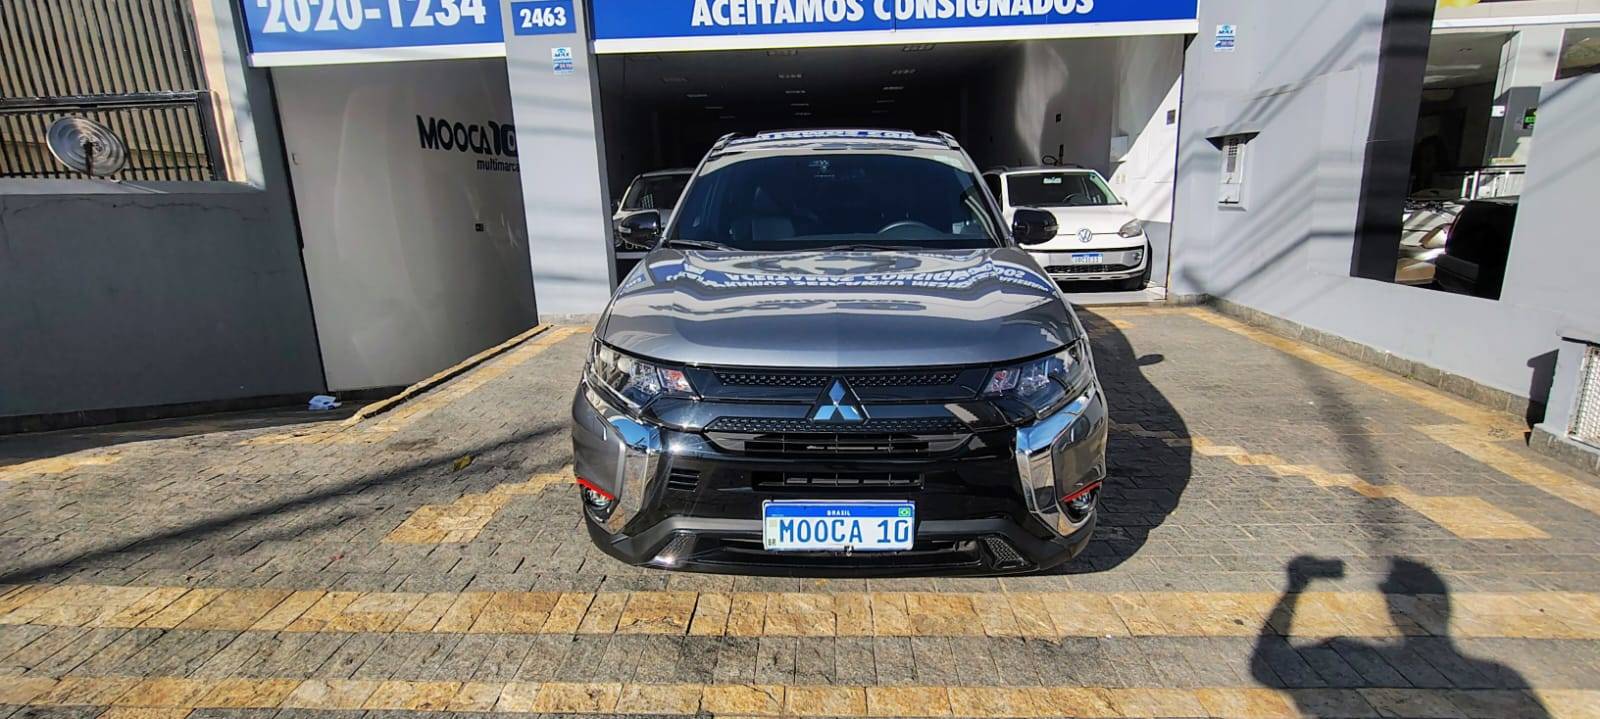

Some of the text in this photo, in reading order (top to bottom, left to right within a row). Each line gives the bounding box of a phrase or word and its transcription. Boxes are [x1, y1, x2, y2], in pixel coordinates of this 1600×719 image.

[258, 0, 486, 33] 2020-1234
[519, 6, 567, 28] 2463
[691, 0, 864, 26] ACEITAMOS
[779, 519, 909, 543] MOOCA 10
